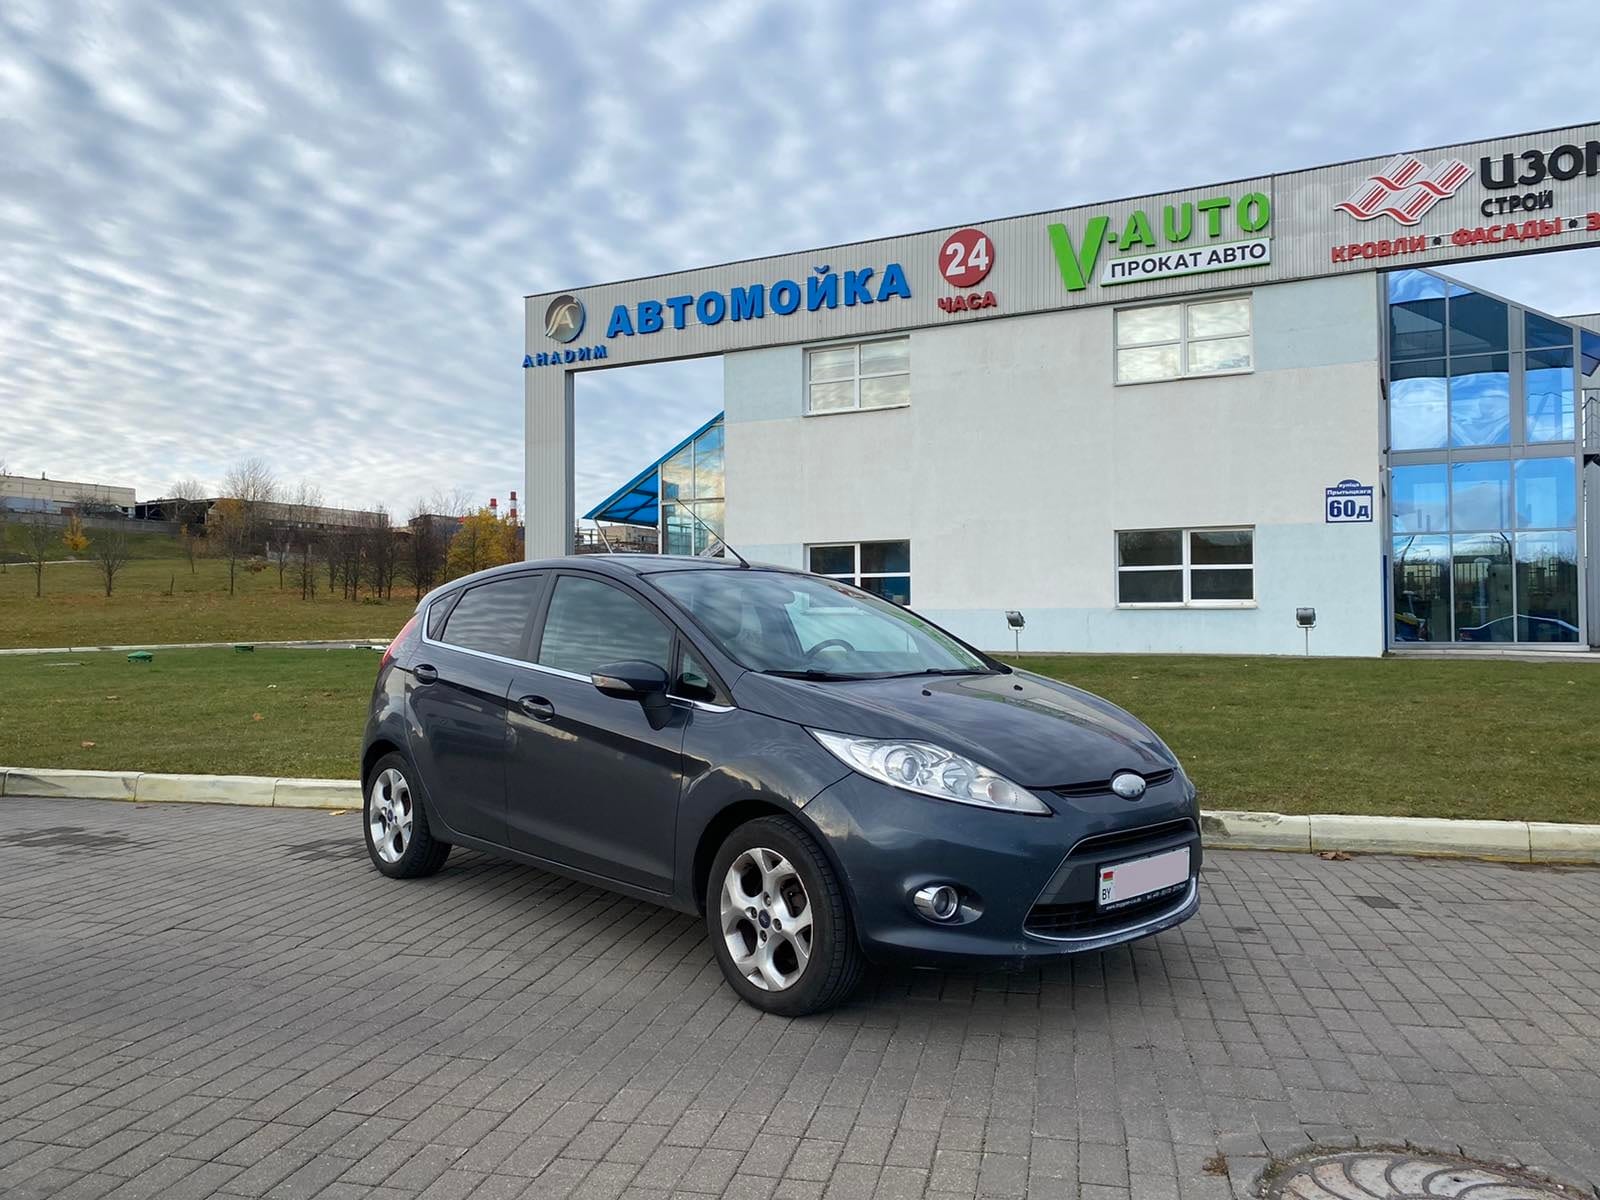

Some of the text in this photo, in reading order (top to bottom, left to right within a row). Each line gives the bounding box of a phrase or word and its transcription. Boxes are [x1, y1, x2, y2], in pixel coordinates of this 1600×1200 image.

[1480, 190, 1553, 217] СТРОЙ
[945, 237, 989, 277] 24
[1047, 192, 1270, 291] V-AUTO
[1331, 235, 1425, 263] КРОВЛИ
[1452, 216, 1562, 246] ФАСАДЫ
[1111, 243, 1266, 278] ПРОКАТ АВТО
[606, 263, 911, 338] АВТОМОЙКА
[937, 291, 997, 313] ЧАСА
[1102, 887, 1111, 900] BY
